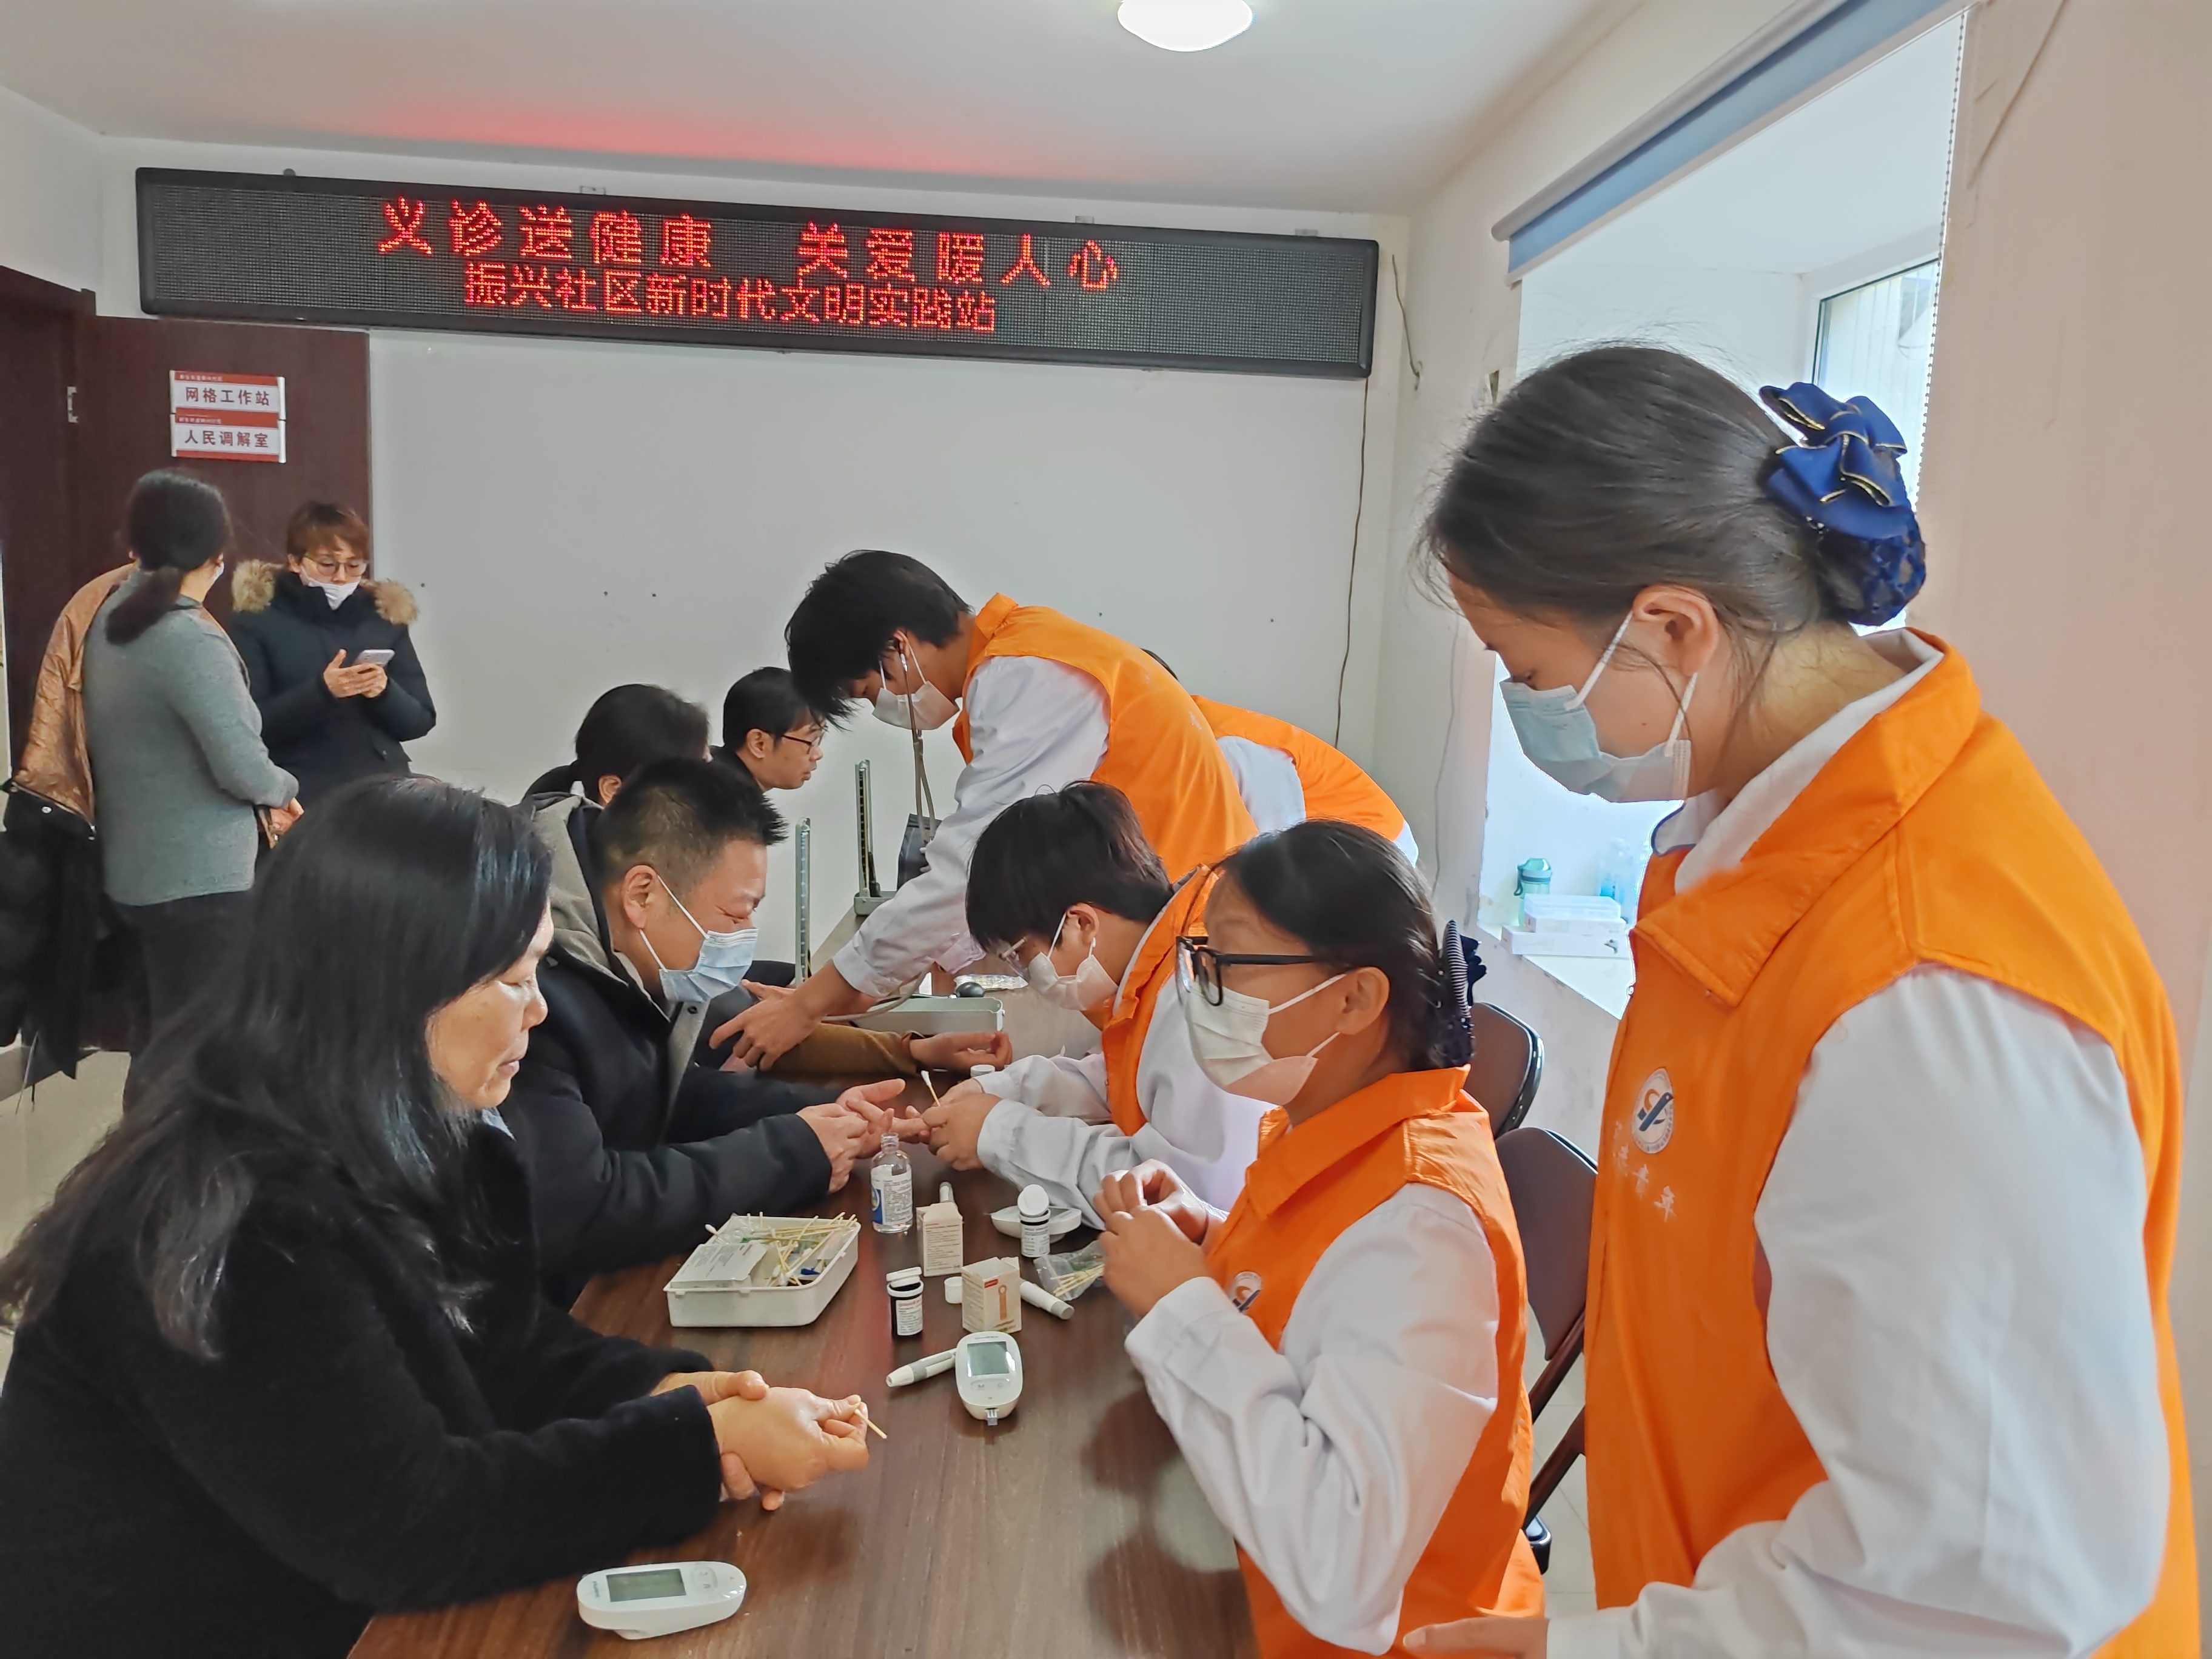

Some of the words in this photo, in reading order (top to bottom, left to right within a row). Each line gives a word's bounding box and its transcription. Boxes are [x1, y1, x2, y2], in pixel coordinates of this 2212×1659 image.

[378, 196, 711, 267] 义诊送健康
[797, 221, 1118, 290] 关爱暖人心
[464, 261, 996, 331] 振兴社区新时代文明实践站
[186, 387, 270, 406] 网格工作站
[184, 429, 269, 447] 人民调解室
